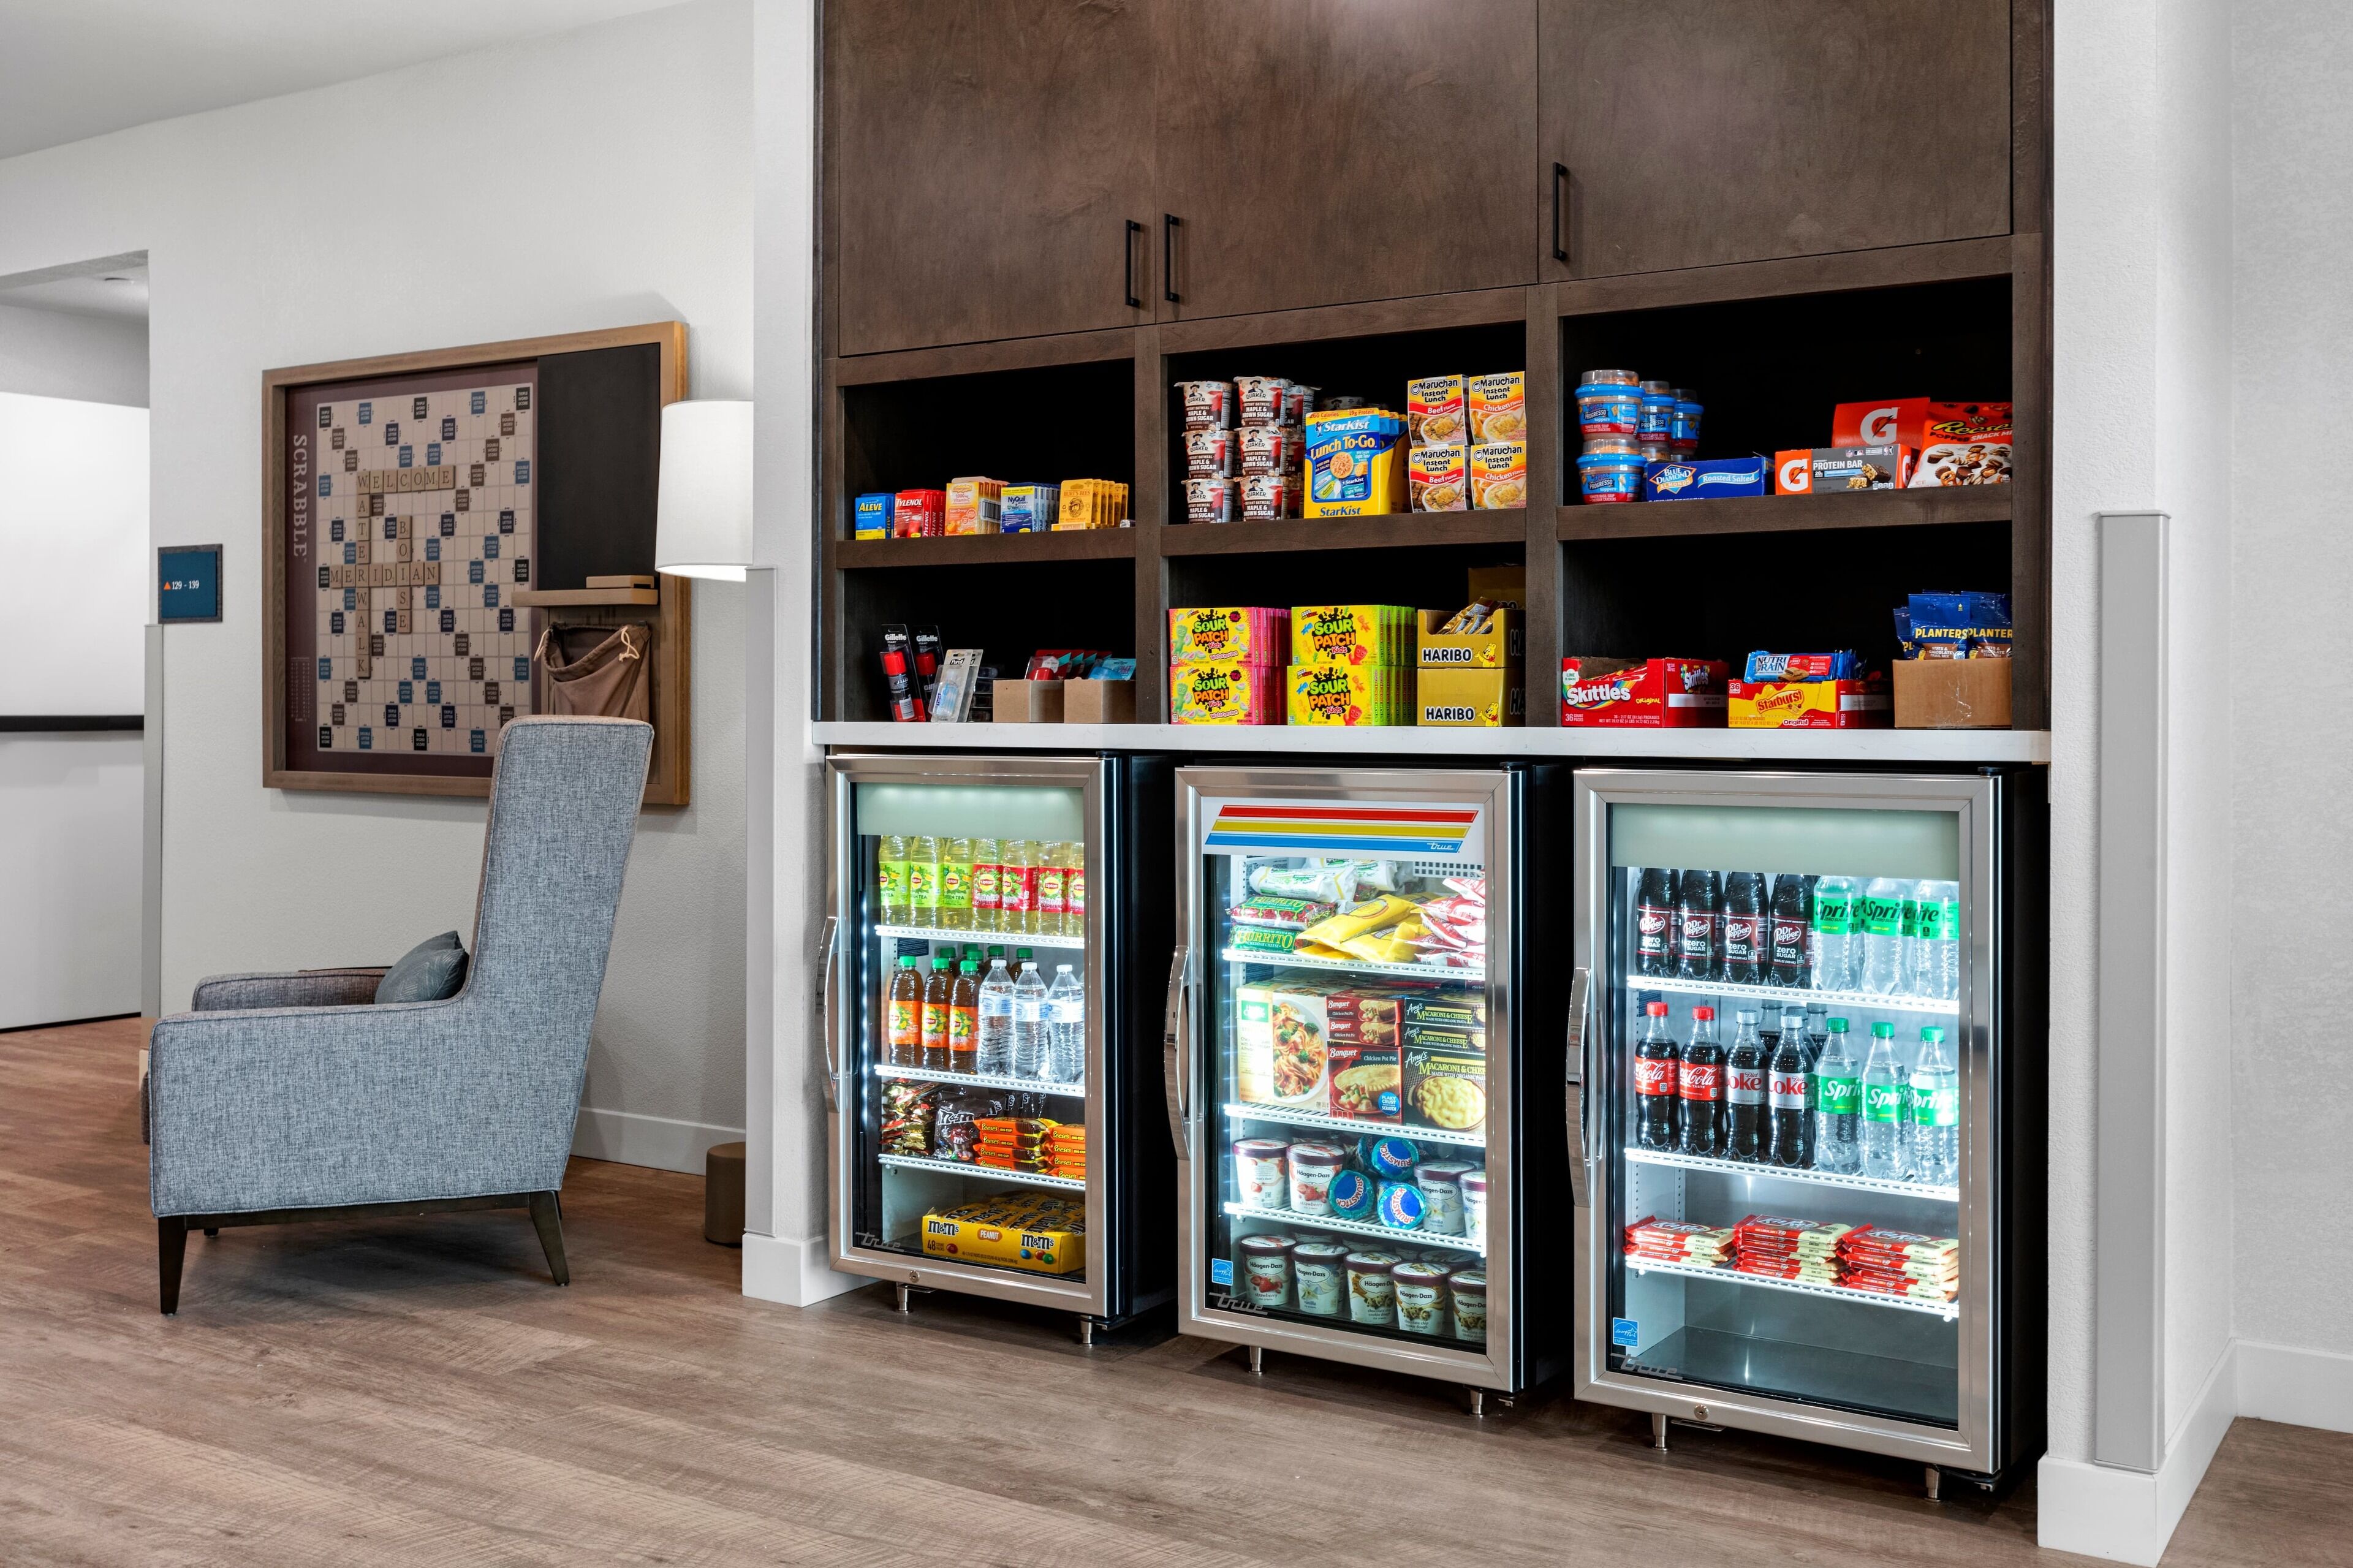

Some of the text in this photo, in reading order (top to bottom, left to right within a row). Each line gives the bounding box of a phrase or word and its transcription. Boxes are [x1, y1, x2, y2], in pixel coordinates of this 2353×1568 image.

[1419, 379, 1458, 390] Maruchan
[1480, 377, 1520, 387] Maruchan
[1422, 388, 1449, 397] Instant
[1483, 403, 1510, 413] Chicken
[1585, 410, 1607, 420] PROGRESSO
[1324, 419, 1370, 432] StarKist
[1971, 432, 2000, 441] SNACK
[1311, 439, 1342, 460] Lunch
[1421, 449, 1460, 458] Maruchan
[1482, 446, 1522, 456] Maruchan
[1813, 460, 1863, 471] PROTEIN BAR
[1485, 471, 1512, 480] Chicken
[1656, 470, 1691, 484] DIAMOND
[1664, 468, 1681, 477] BLUE
[357, 470, 450, 488] WELCOME
[1590, 480, 1613, 490] PROGRESSO
[1660, 480, 1691, 490] ALMONDS
[293, 434, 306, 557] SCRABBLE
[858, 502, 882, 512] ALEVE
[1319, 506, 1362, 517] StarKist
[330, 567, 436, 583] MERIDIAN
[172, 581, 182, 589] 129
[189, 580, 199, 589] 139
[1194, 619, 1226, 633] SOUR
[1314, 619, 1353, 635] SOUR
[1194, 631, 1229, 644] PATCH
[1915, 628, 1968, 640] PLANTERS
[1968, 627, 2012, 638] PLANTER
[1313, 632, 1356, 650] PATCH
[1210, 650, 1238, 661] Watermelon
[1332, 646, 1348, 654] Kids
[1423, 648, 1472, 661] HARIBO
[1757, 657, 1787, 665] NUTRI
[1194, 677, 1227, 691] SOUR
[1684, 668, 1709, 690] Skittles
[1309, 679, 1348, 694] SOUR
[1194, 689, 1229, 703] PATCH
[1309, 692, 1351, 709] PATCH
[1567, 684, 1631, 705] Skittles
[1757, 690, 1803, 711] Starburst
[1210, 710, 1239, 719] Watermelon
[1426, 707, 1474, 720] HARIBO
[1565, 713, 1574, 722] 36
[1815, 900, 1859, 920] Sprite
[1683, 921, 1708, 935] Pepper
[1238, 931, 1294, 949] BURRITO
[1774, 928, 1800, 942] Pepper
[1407, 1003, 1423, 1015] Amy's
[1417, 1011, 1446, 1020] MACARONI
[1450, 1013, 1472, 1024] CHEESE
[1330, 1021, 1351, 1030] Banquet
[1404, 1027, 1420, 1039] Amy's
[1329, 1048, 1358, 1058] Banquet
[1404, 1051, 1428, 1068] Amy's
[1419, 1062, 1460, 1075] MACARONI
[980, 1148, 996, 1156] Reese's
[1336, 1176, 1364, 1208] DRUMSTICK
[980, 1230, 999, 1240] PEANUT
[927, 1240, 936, 1251] 48
